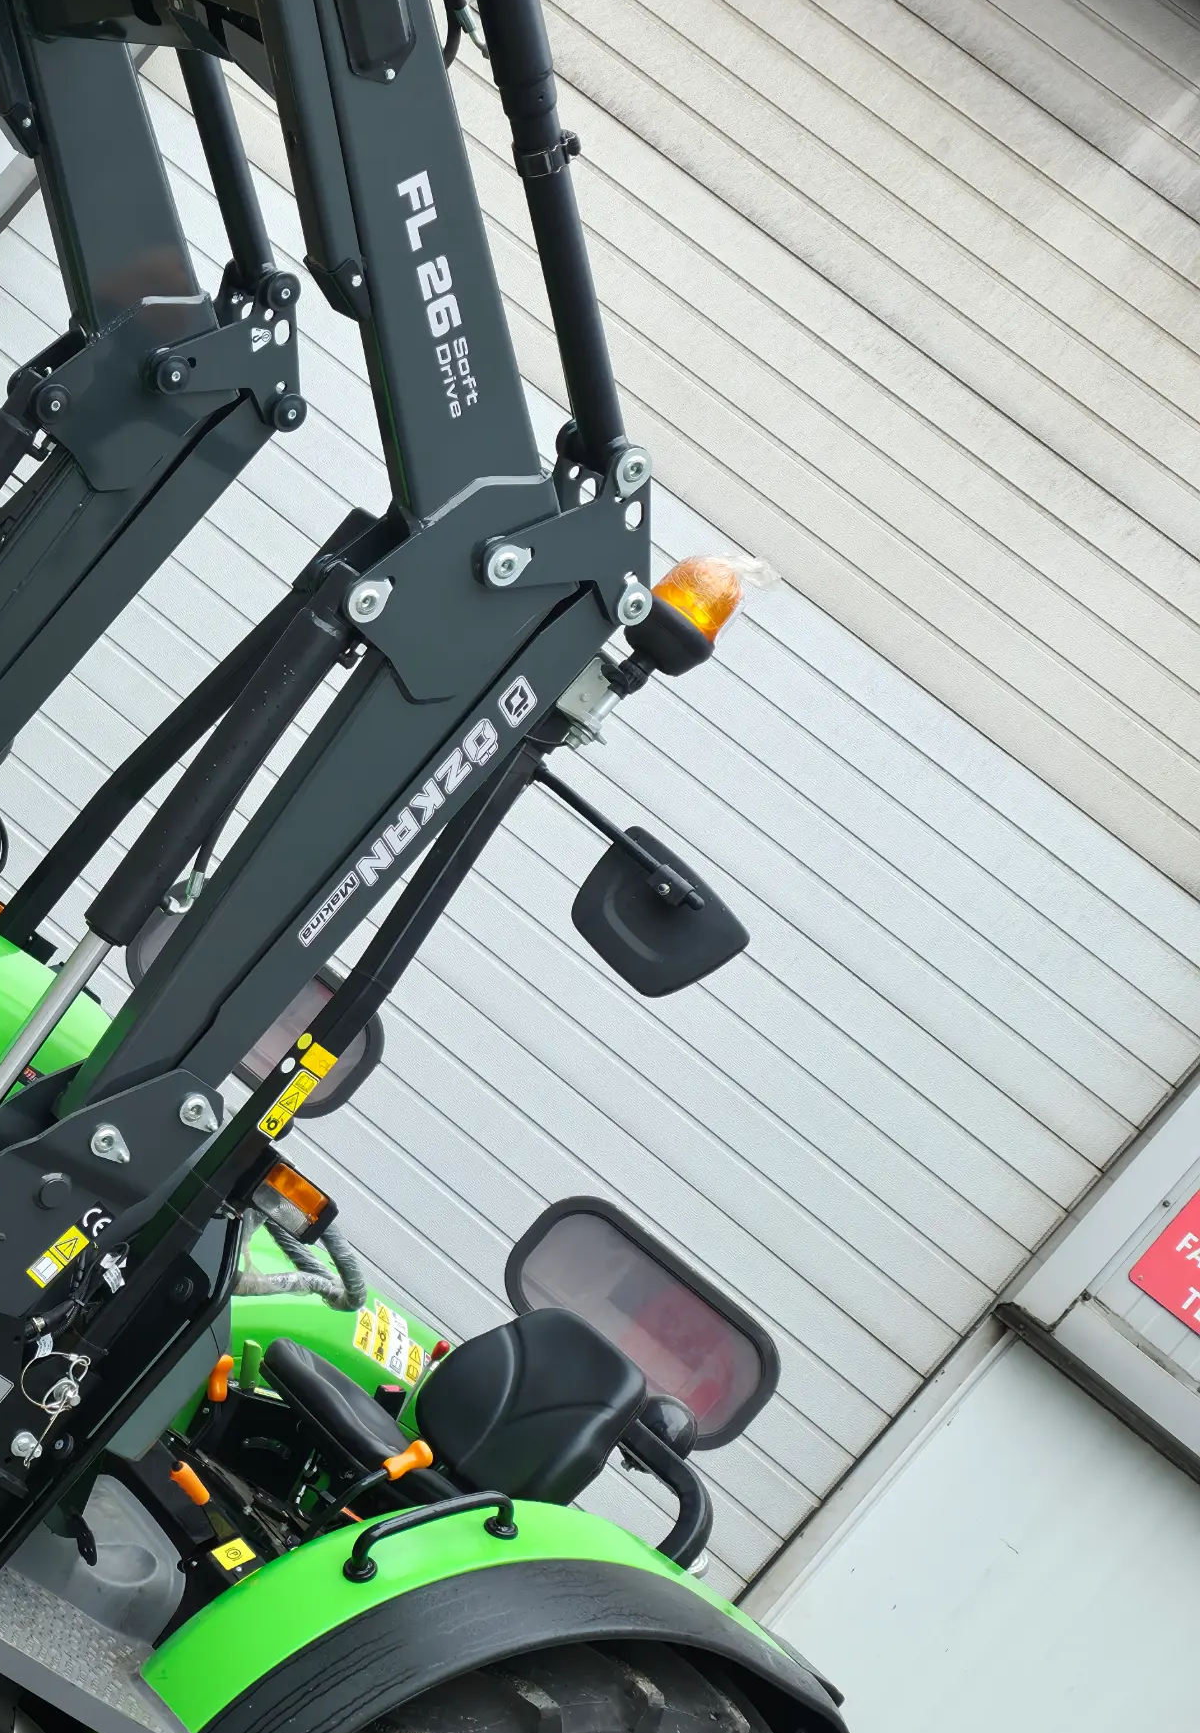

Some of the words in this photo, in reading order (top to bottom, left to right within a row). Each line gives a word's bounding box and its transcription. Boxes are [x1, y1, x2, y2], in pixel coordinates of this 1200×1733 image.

[397, 171, 438, 252] FL
[416, 254, 462, 338] 26
[436, 342, 463, 419] Drive
[453, 336, 481, 407] Soft
[358, 718, 499, 886] ÖZKAN
[300, 875, 356, 942] Makina
